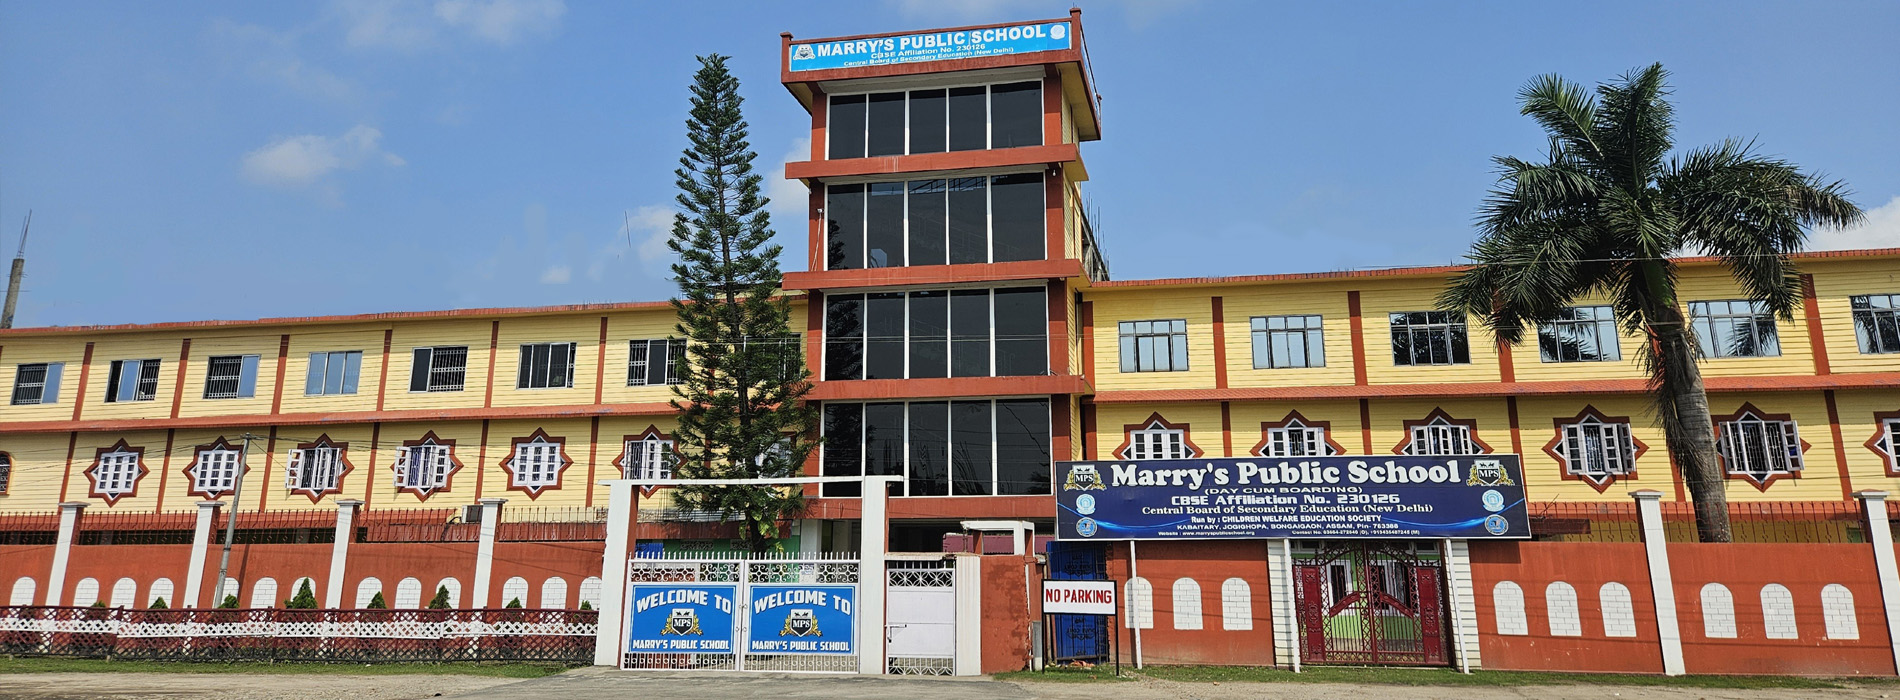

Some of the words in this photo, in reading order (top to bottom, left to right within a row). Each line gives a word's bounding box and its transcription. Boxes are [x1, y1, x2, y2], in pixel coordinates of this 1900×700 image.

[818, 39, 894, 57] MARRY'S
[900, 32, 966, 50] PUBLIC
[972, 25, 1046, 44] SCHOOL
[898, 49, 938, 57] Affiliation
[956, 44, 985, 52] 230126
[900, 54, 936, 62] Secondary
[1075, 474, 1094, 482] MPS
[1111, 463, 1229, 490] Marry's
[1237, 462, 1340, 484] Public
[1348, 460, 1461, 484] School
[1172, 496, 1209, 505] CBSE
[1215, 495, 1297, 505] Affiliation
[1304, 494, 1331, 504] No.
[1337, 494, 1400, 504] 230126
[1142, 506, 1183, 514] Central
[1186, 506, 1221, 514] Board
[1223, 506, 1235, 514] of
[1238, 505, 1297, 514] Secondary
[1363, 504, 1393, 513] (New
[1397, 504, 1433, 513] Delhi)
[1207, 516, 1216, 524] by
[637, 589, 709, 613] WELCOME
[714, 594, 732, 614] TO
[1046, 589, 1061, 602] NO
[1064, 590, 1112, 604] PARKING
[754, 590, 827, 614] WELCOME
[833, 595, 851, 615] TO
[674, 619, 691, 627] MPS
[793, 620, 810, 628] MPS
[633, 640, 668, 649] MARRY'S
[670, 640, 698, 649] PUBLIC
[701, 640, 729, 650] SCHOOL
[752, 641, 788, 650] MARRY'S
[790, 641, 817, 650] PUBLIC
[820, 642, 849, 651] SCHOOL
